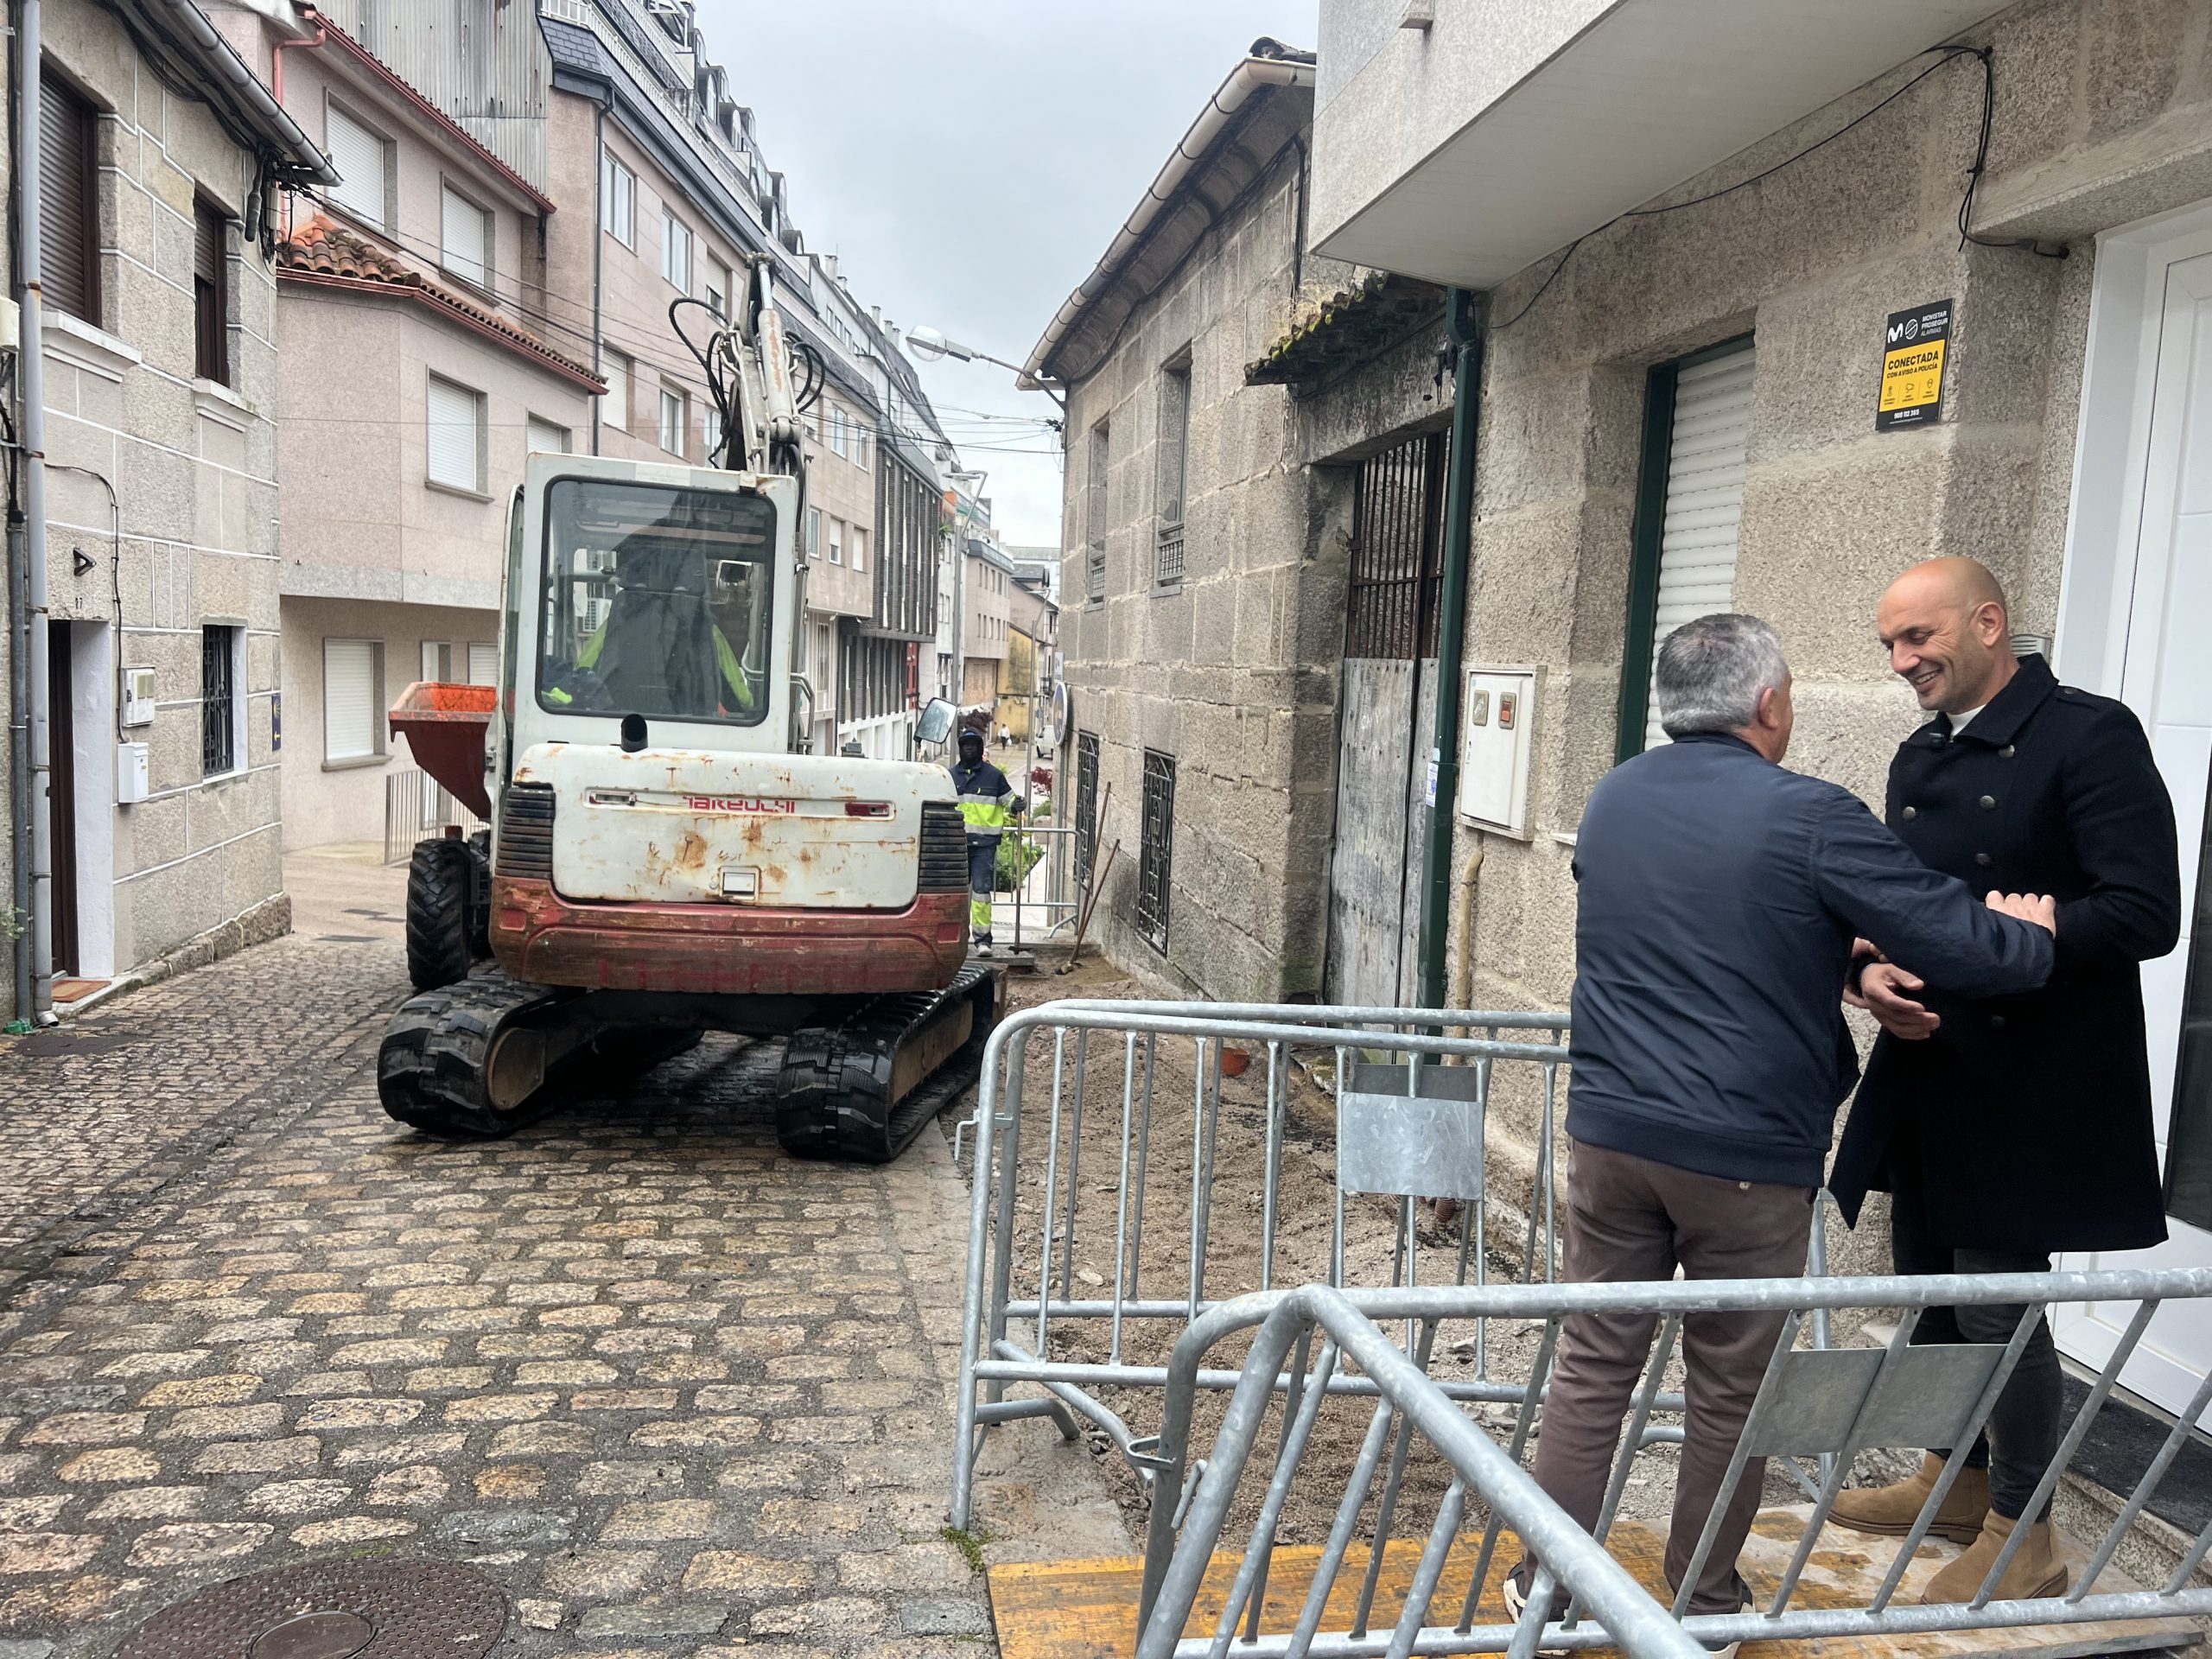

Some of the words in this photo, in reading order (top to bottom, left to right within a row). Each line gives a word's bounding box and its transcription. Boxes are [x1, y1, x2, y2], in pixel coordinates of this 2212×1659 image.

[1923, 310, 1947, 322] MOVISTAR
[1922, 318, 1948, 329] PROSEGUR
[1921, 327, 1942, 336] ALARMAS
[1889, 351, 1939, 370] CONECTADA
[1898, 368, 1913, 377] AVISO
[1918, 362, 1938, 372] POLICÍA
